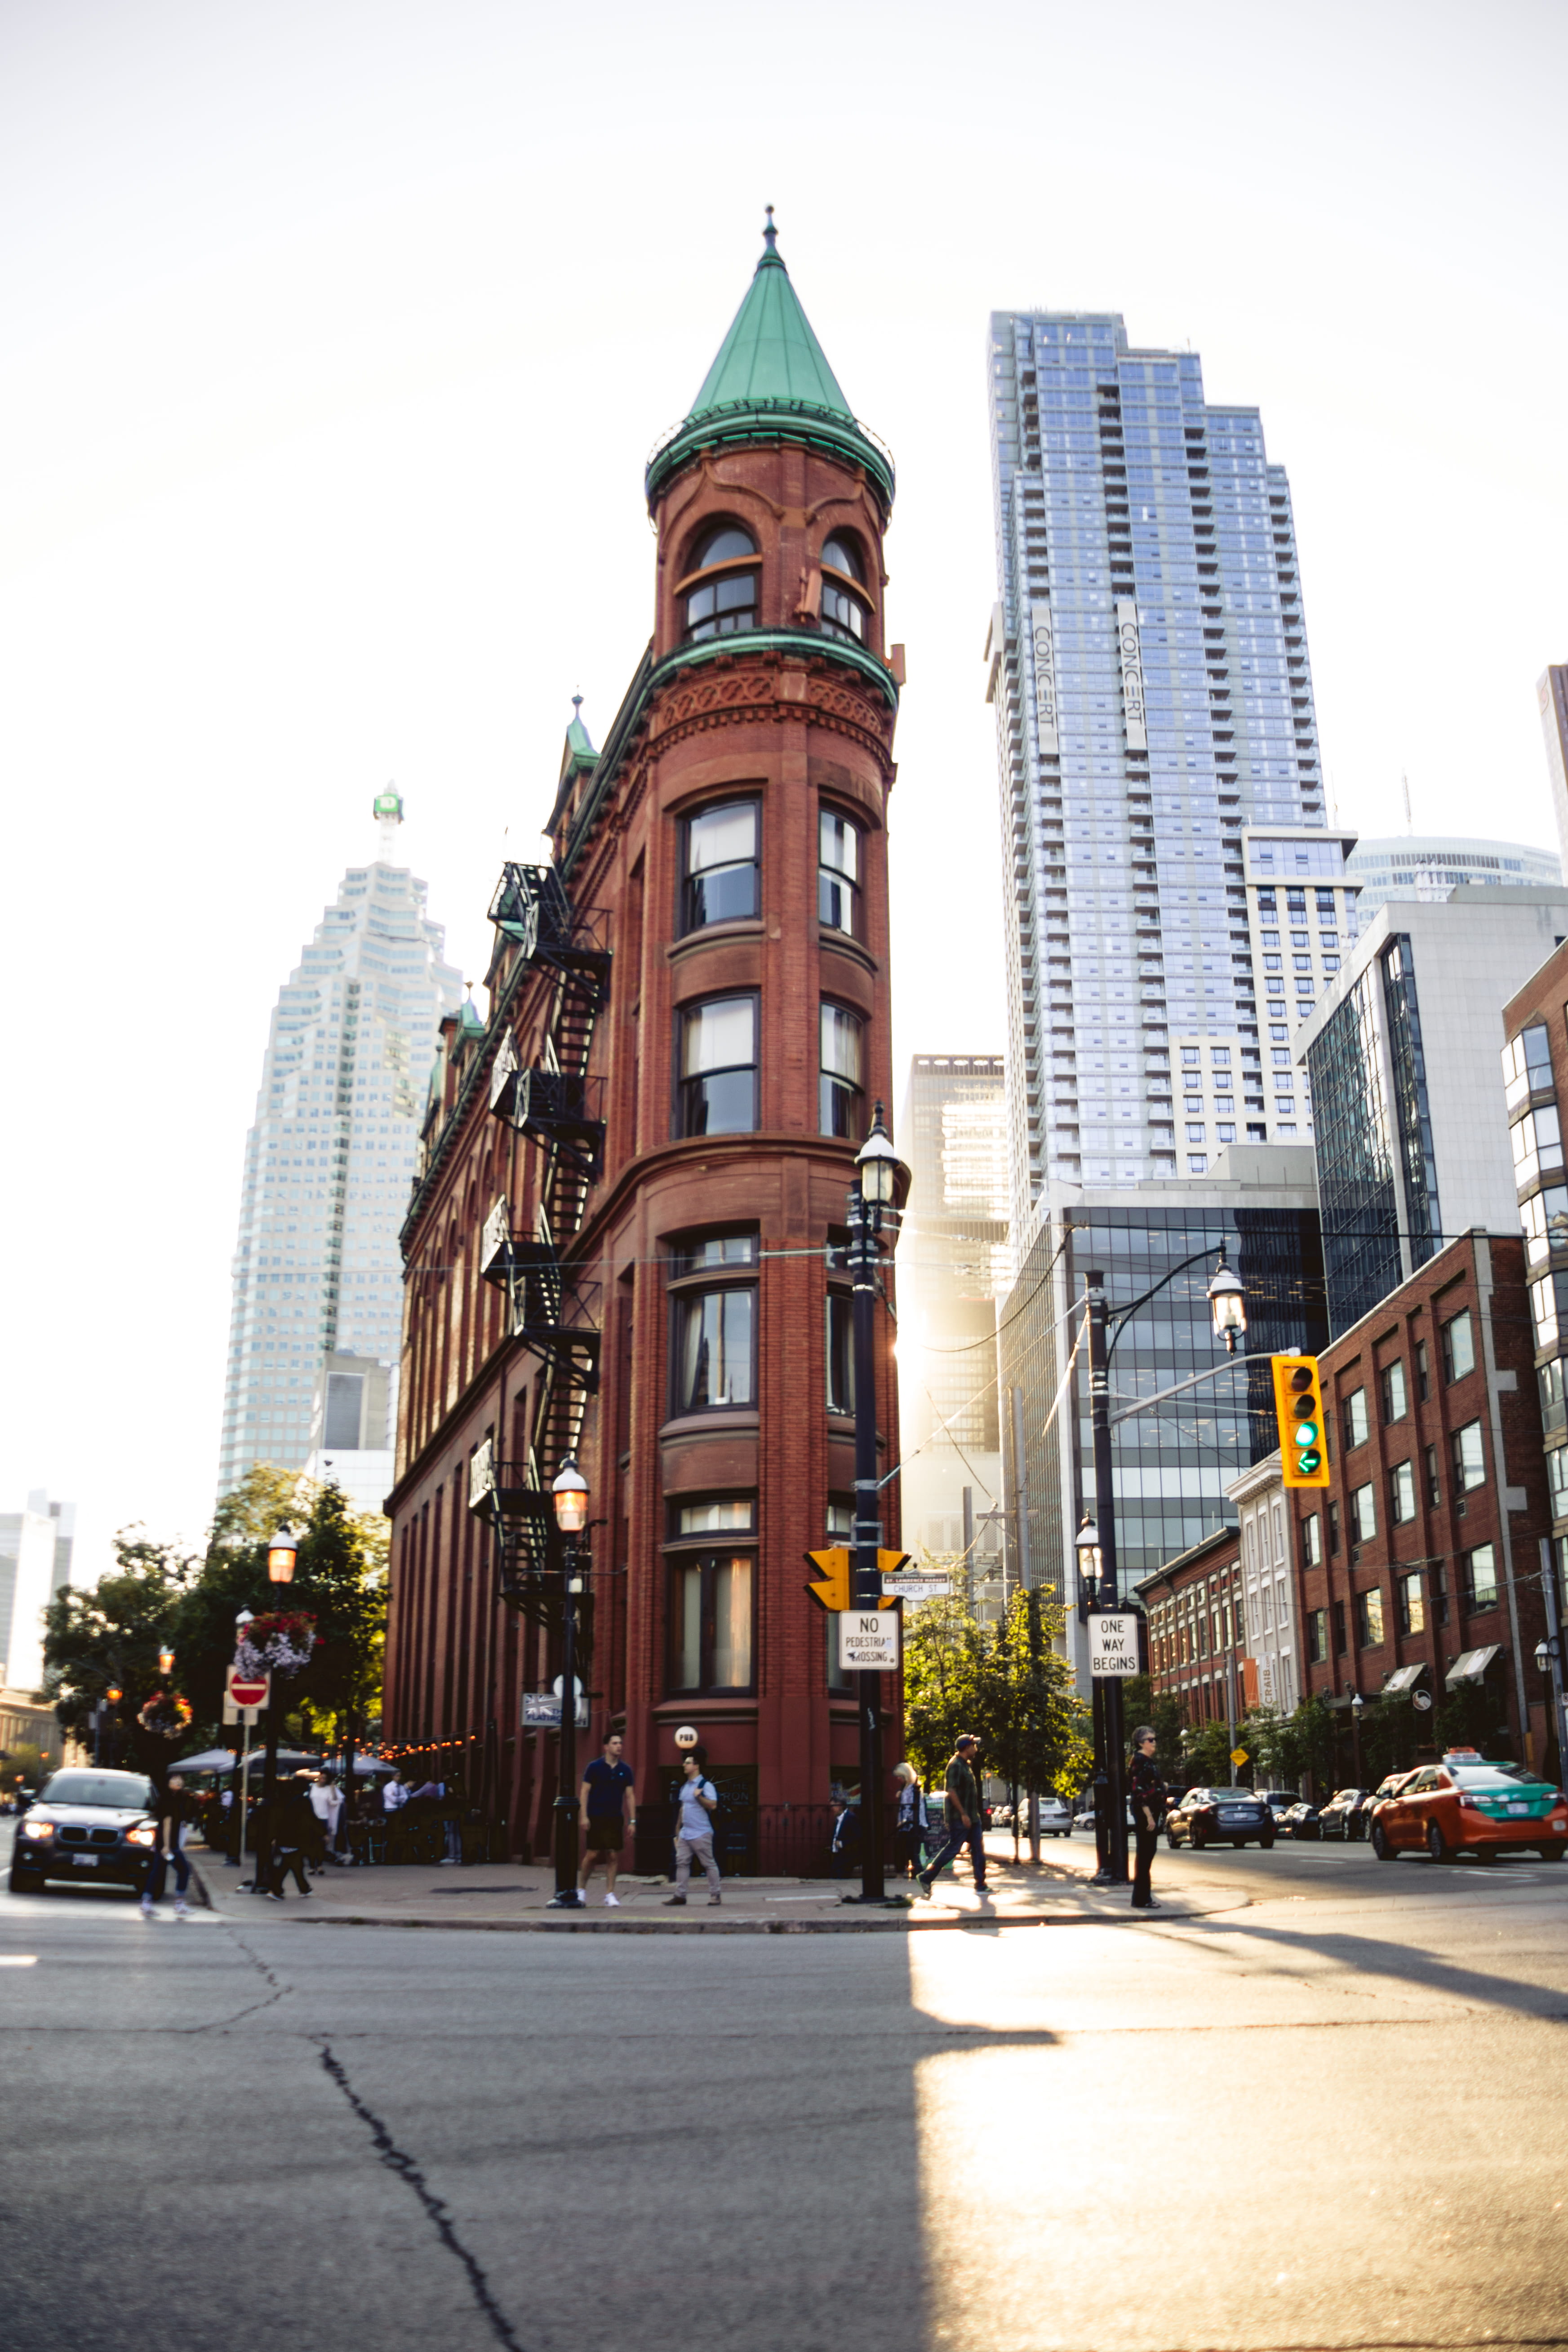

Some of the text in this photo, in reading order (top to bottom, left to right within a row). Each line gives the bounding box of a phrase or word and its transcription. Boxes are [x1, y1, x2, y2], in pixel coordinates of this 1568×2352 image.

[1035, 626, 1054, 728] CONCERT
[1121, 622, 1143, 725] CONCERT
[380, 796, 396, 809] TD
[893, 1584, 923, 1593] CHURCH
[860, 1617, 879, 1633] NO
[1101, 1620, 1125, 1633] ONE
[1102, 1638, 1124, 1651] WAY
[1093, 1656, 1136, 1670] BEGINS
[680, 1734, 693, 1742] PUB
